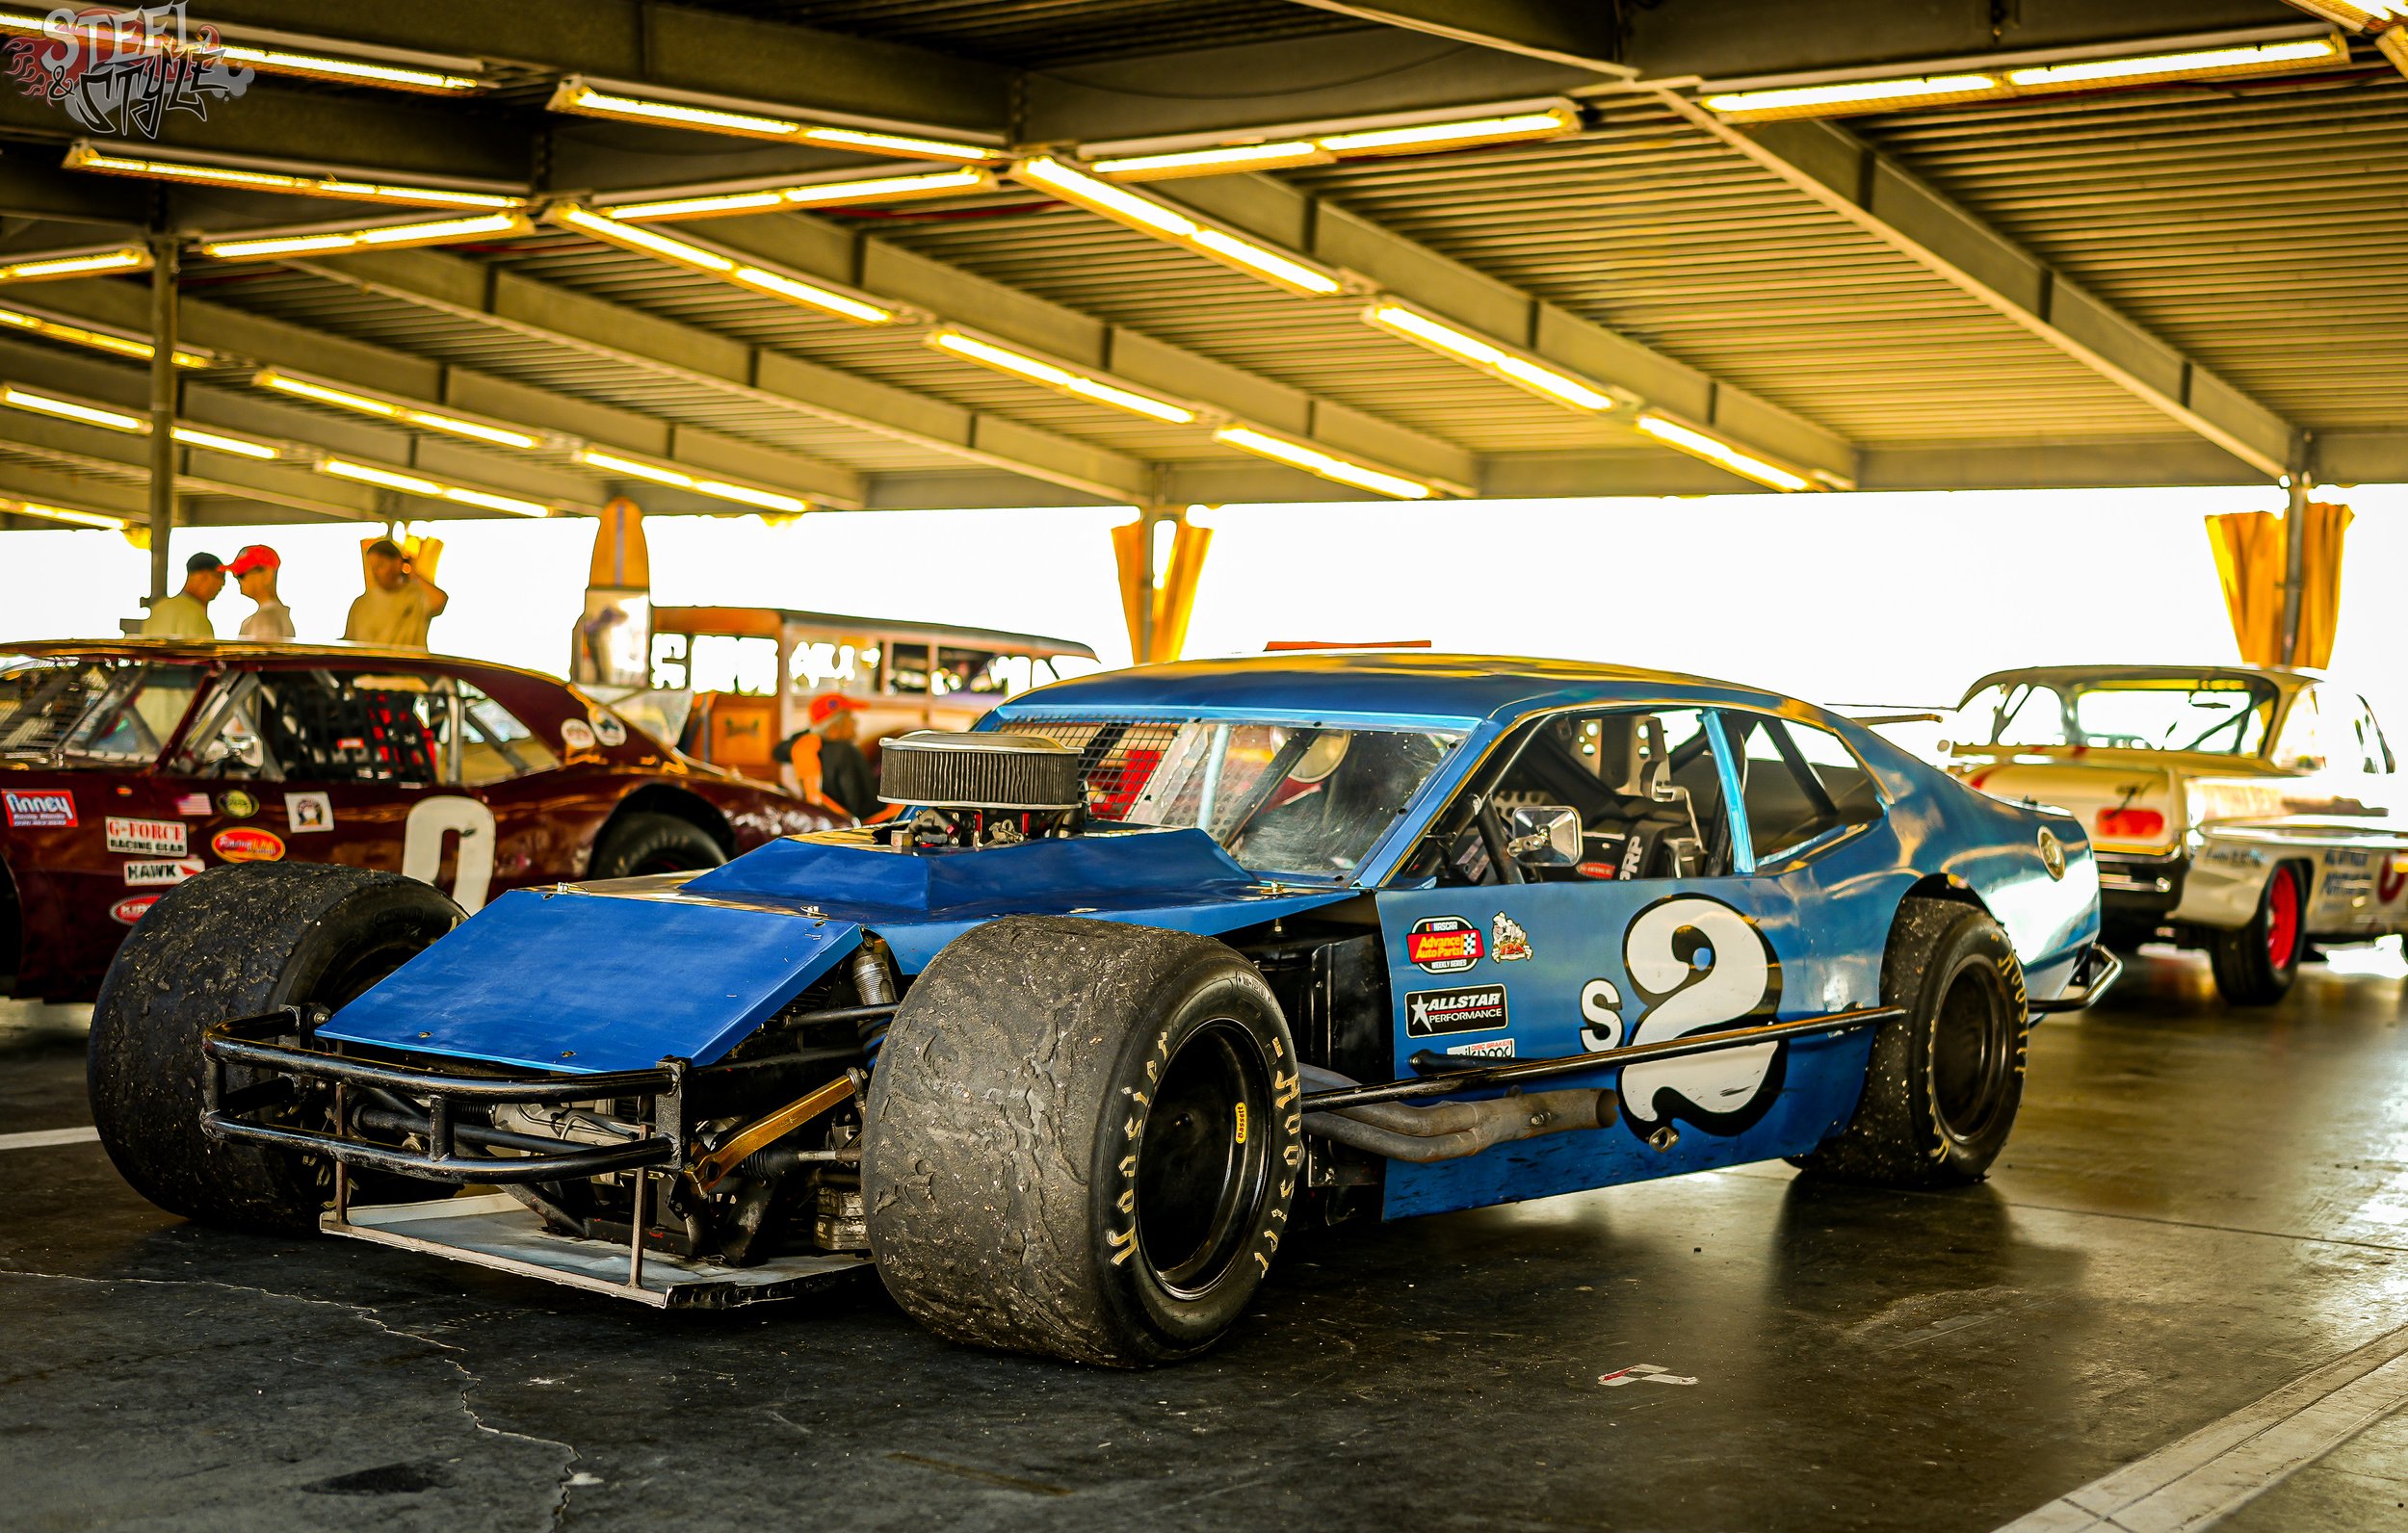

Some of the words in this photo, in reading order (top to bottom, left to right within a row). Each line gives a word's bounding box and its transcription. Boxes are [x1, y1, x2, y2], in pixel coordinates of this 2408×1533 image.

[108, 819, 187, 843] G-FORCE
[110, 839, 152, 850] RACING
[155, 843, 184, 852] GEAR
[127, 864, 176, 879] HAWK
[1433, 921, 1458, 931] NASCAR
[1419, 935, 1461, 948] Advance
[1415, 948, 1438, 959] Auto
[1438, 947, 1461, 956] Parts
[1426, 992, 1503, 1012] ALLSTAR
[1428, 1007, 1503, 1024] PERFORMANCE
[1622, 895, 1783, 1129] 2
[1486, 1039, 1510, 1049] BRAKES
[1237, 1105, 1245, 1139] Bassett
